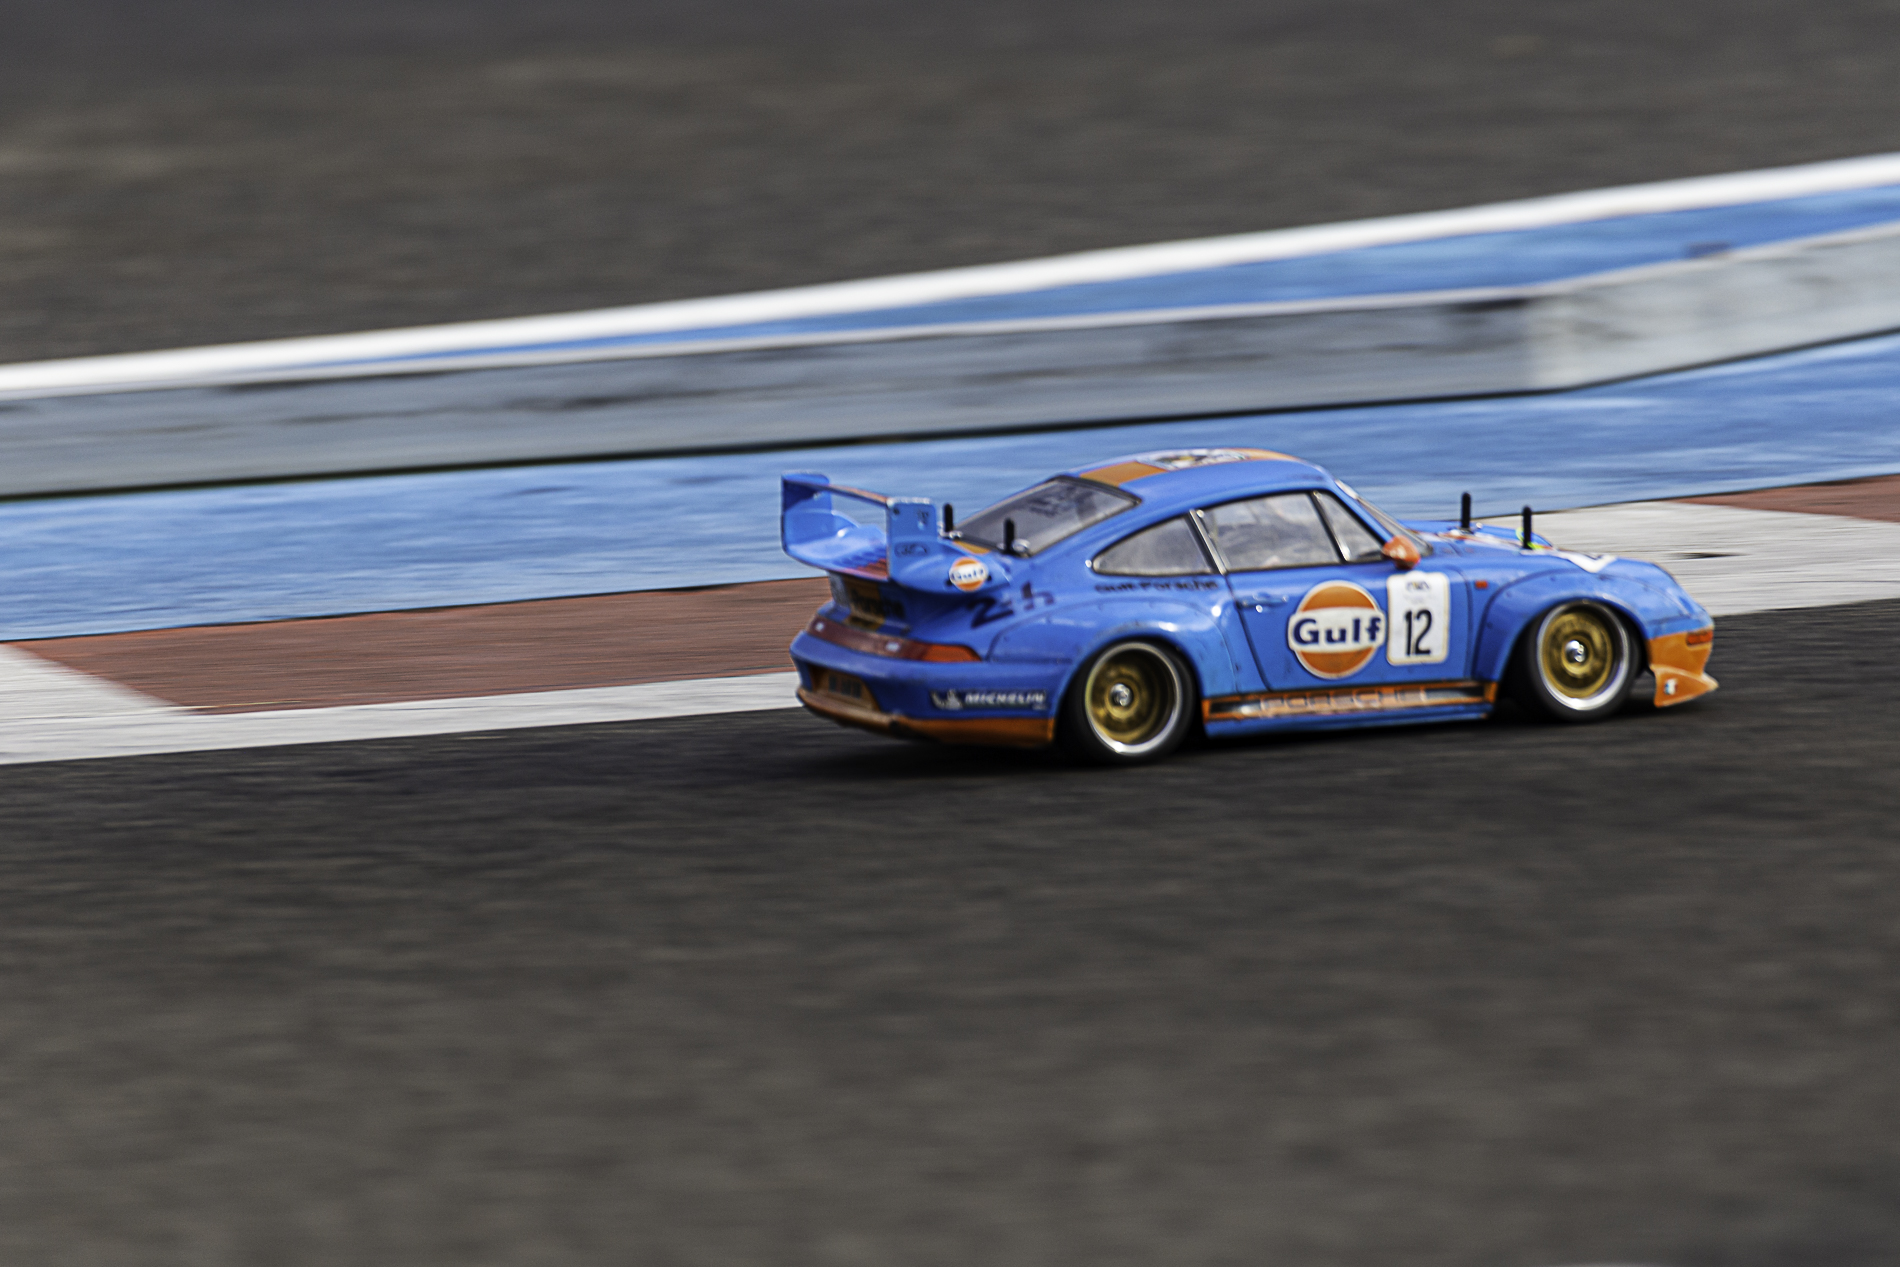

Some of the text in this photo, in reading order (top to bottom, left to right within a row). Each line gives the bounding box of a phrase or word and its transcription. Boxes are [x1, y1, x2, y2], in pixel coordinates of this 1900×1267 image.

[1293, 617, 1381, 644] Gulf
[1405, 609, 1432, 656] 12
[965, 691, 1045, 704] MICHELIN
